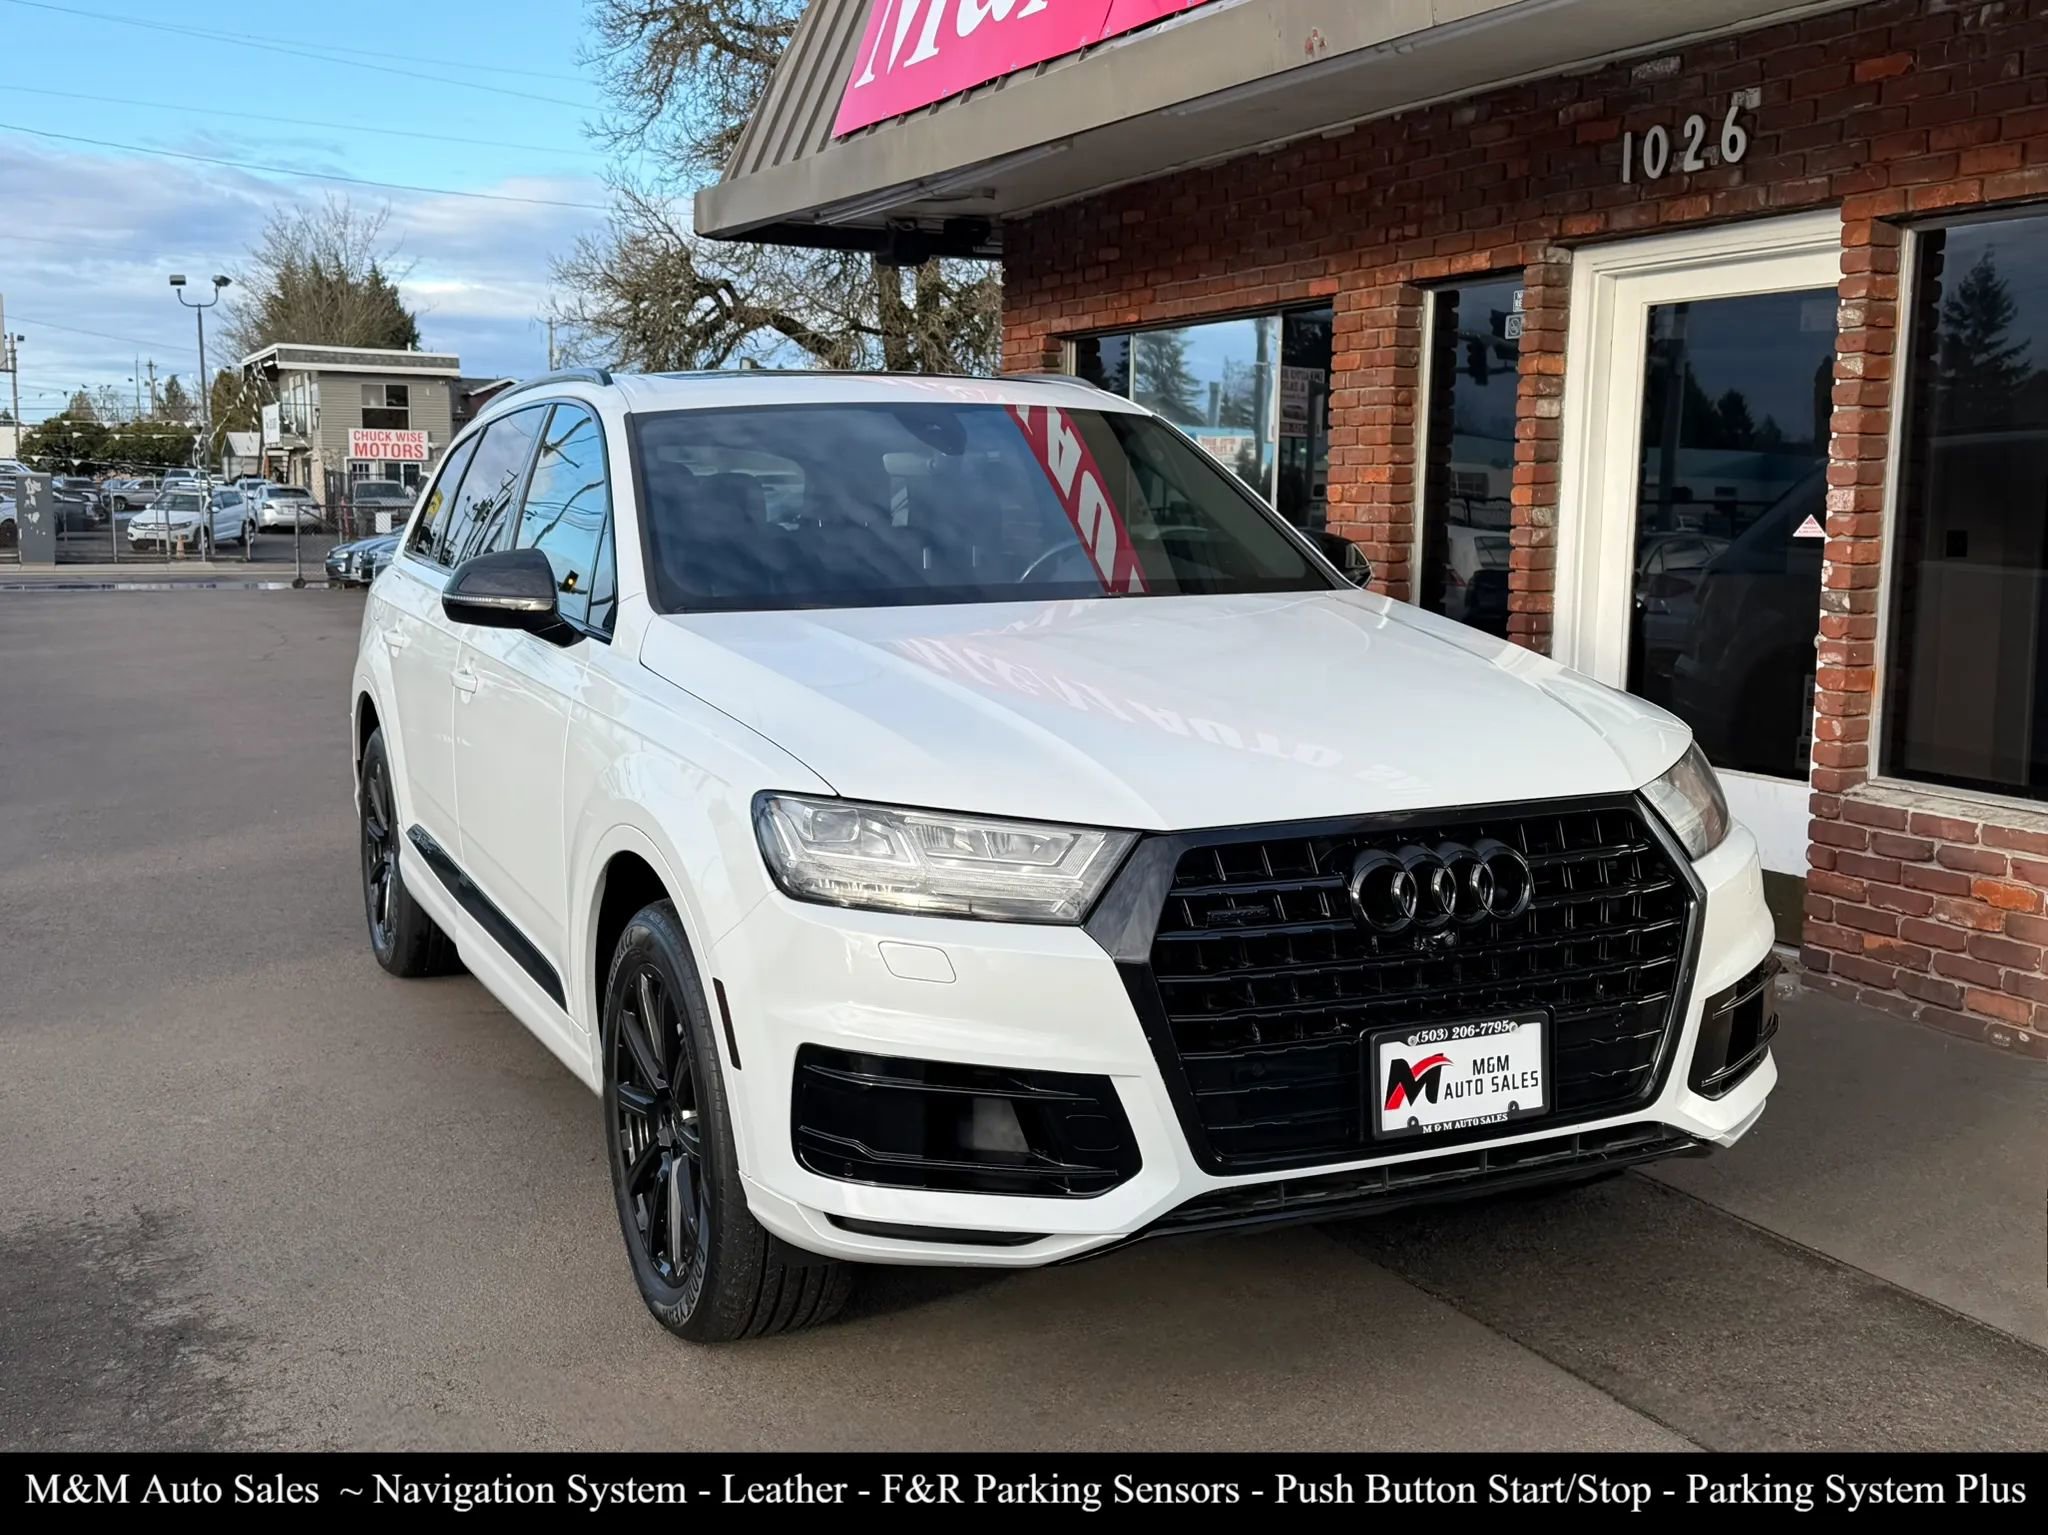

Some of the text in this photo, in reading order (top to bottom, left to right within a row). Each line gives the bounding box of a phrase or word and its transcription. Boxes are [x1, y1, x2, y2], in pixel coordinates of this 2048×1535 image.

[1622, 104, 1747, 184] 1026
[353, 430, 424, 443] CHUCK WISE
[354, 442, 424, 459] MOTORS
[1416, 1020, 1510, 1044] (503) 206-7795
[1472, 1055, 1510, 1076] M&M
[1444, 1071, 1539, 1100] AUTO SALES
[1455, 1118, 1479, 1129] AUTO
[1479, 1113, 1508, 1124] SALES
